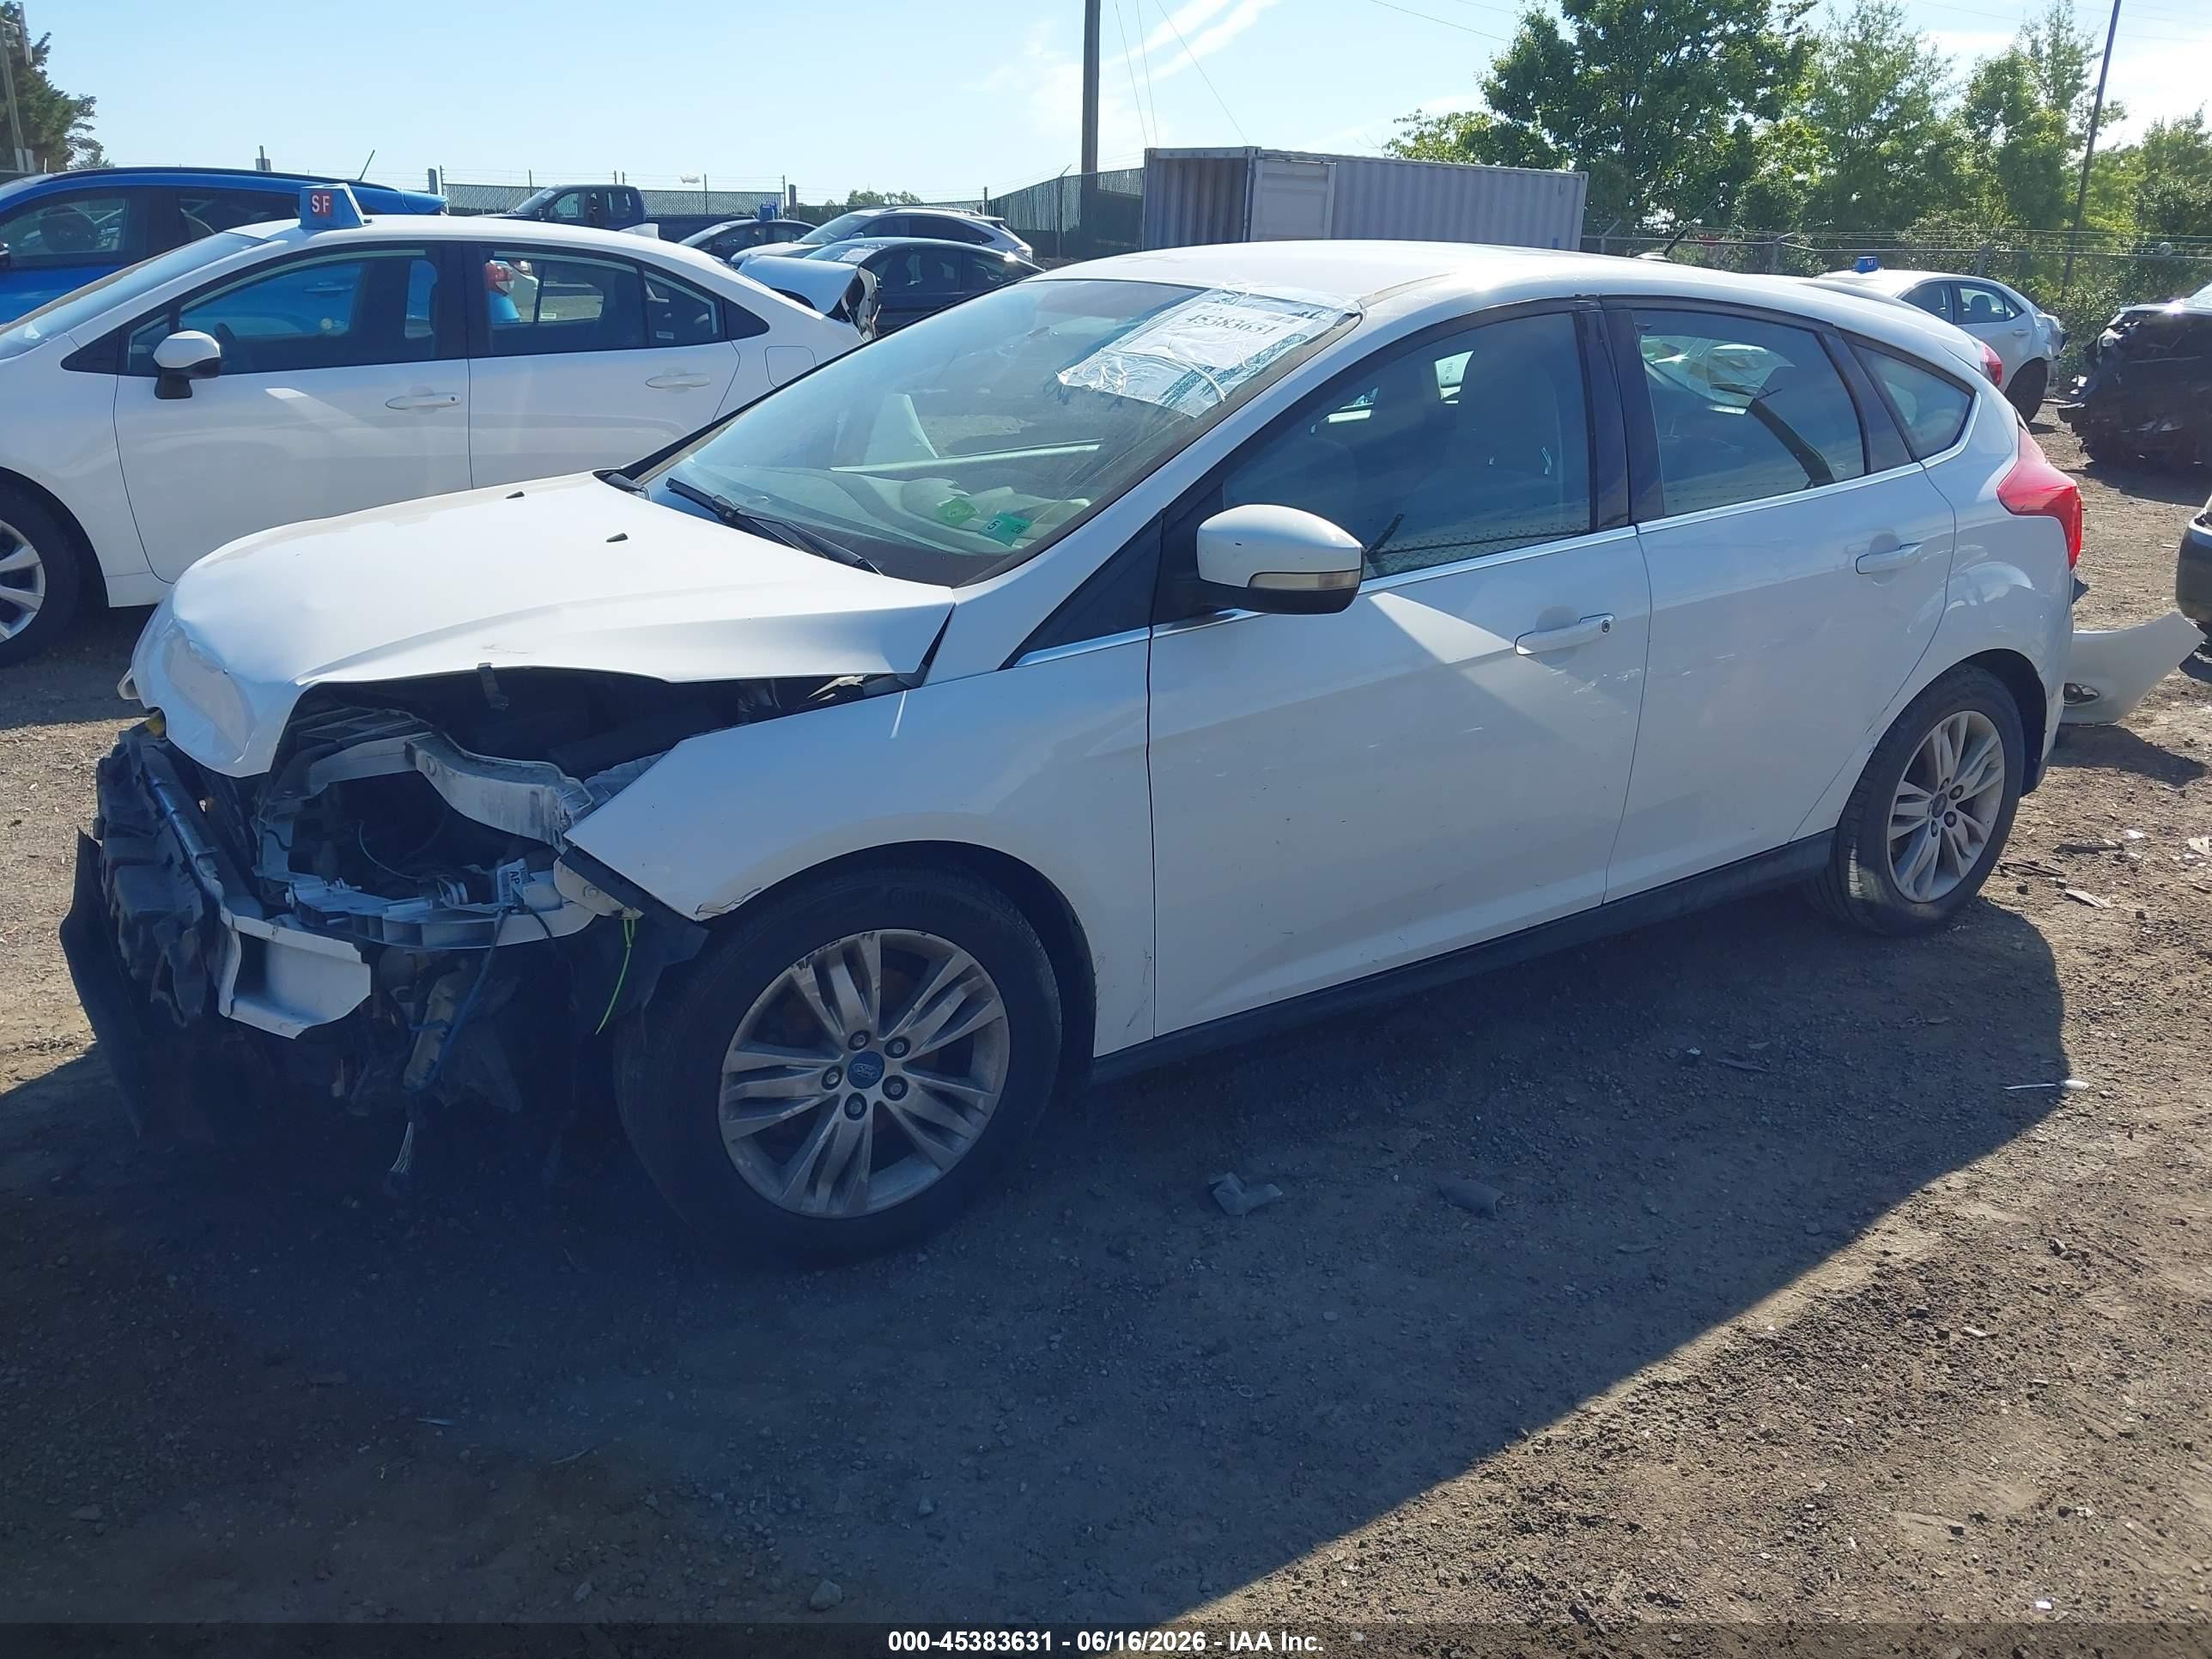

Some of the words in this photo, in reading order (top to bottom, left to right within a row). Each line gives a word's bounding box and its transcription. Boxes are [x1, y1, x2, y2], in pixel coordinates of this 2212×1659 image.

[311, 194, 331, 213] SF
[1187, 314, 1279, 335] 45383631
[988, 520, 1000, 530] 5
